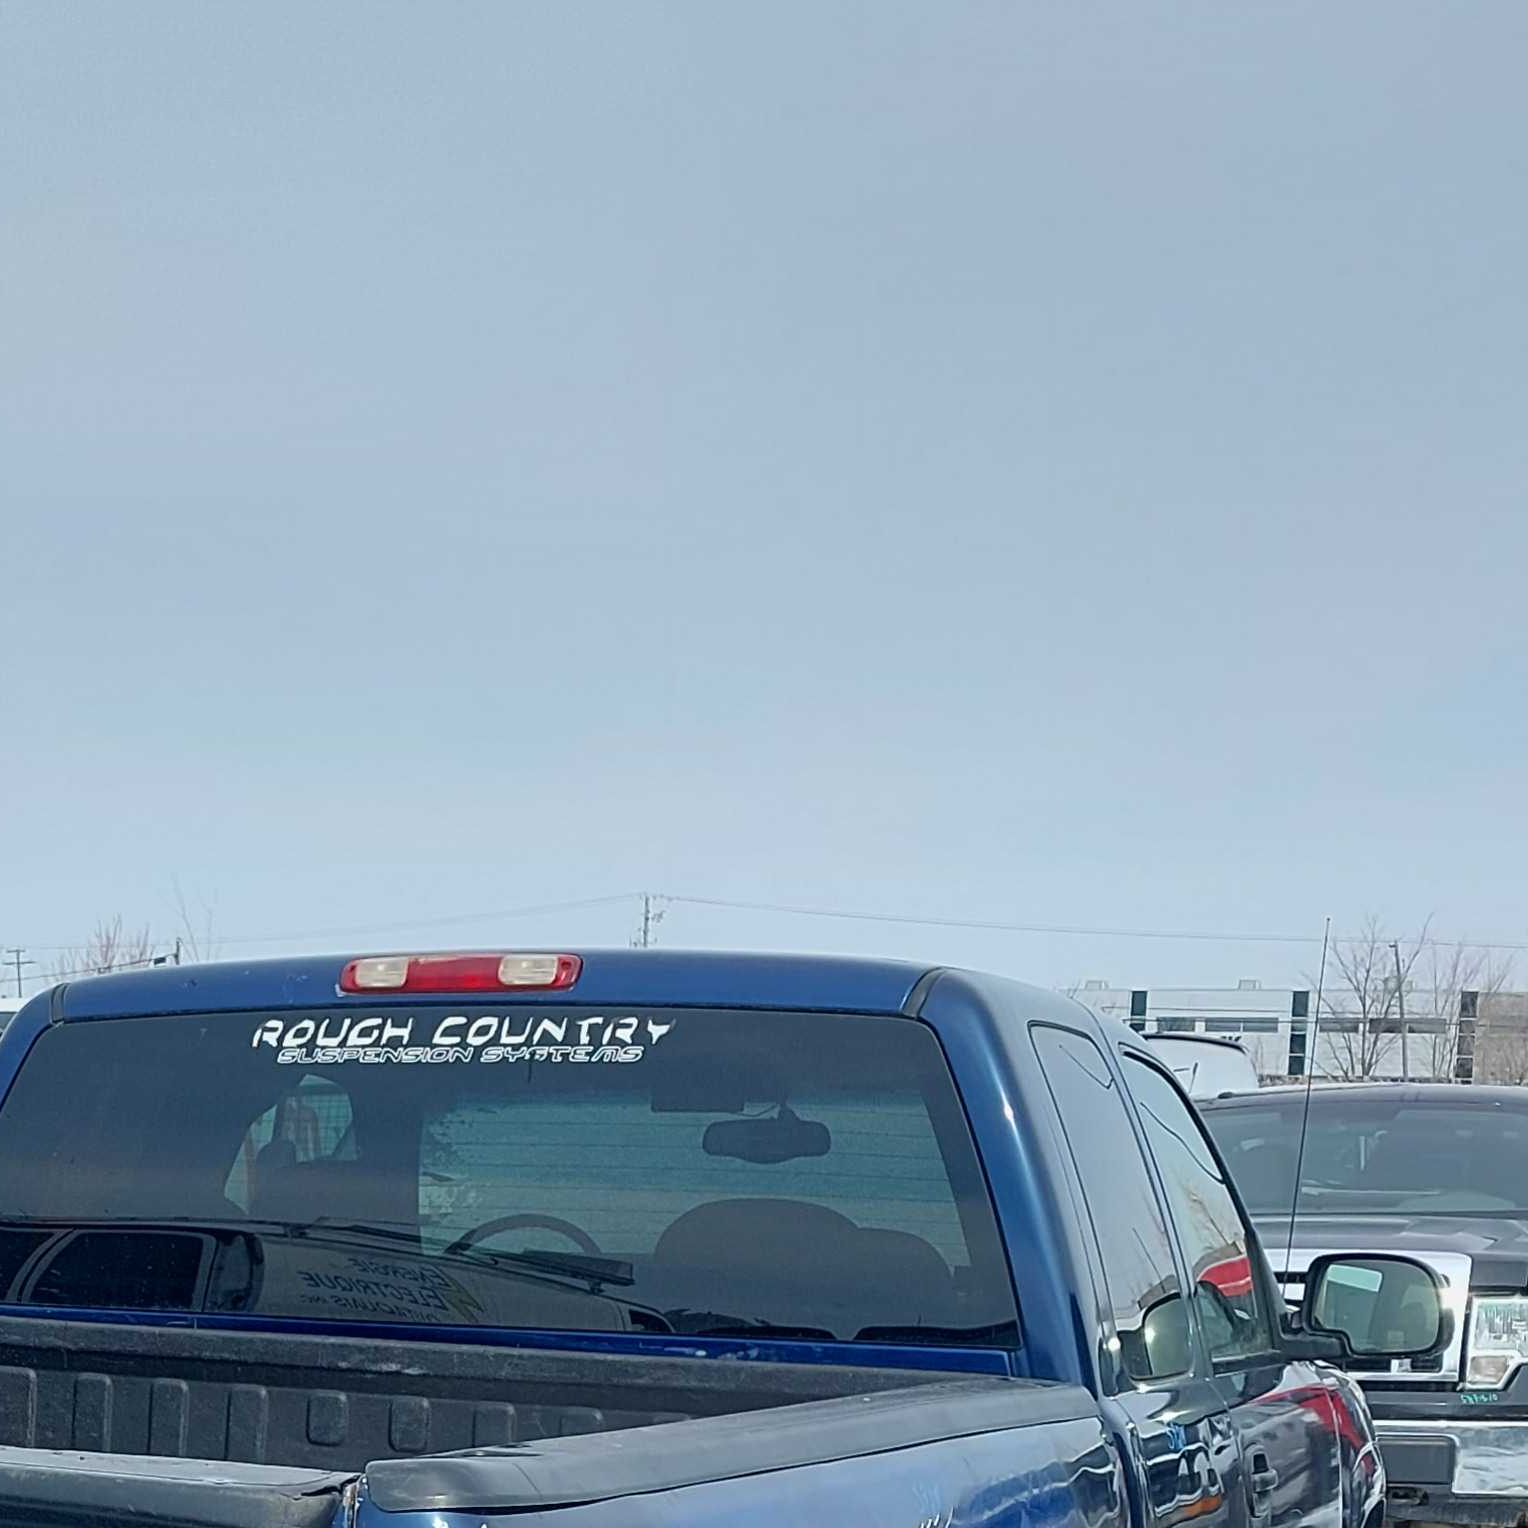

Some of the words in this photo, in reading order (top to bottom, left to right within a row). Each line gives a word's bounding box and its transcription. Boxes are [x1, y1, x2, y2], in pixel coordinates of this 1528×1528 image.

[252, 1017, 414, 1048] ROUGH
[431, 1016, 677, 1046] COUNTRY
[277, 1046, 473, 1064] SUSPENSION
[480, 1046, 644, 1063] SYSTEMS
